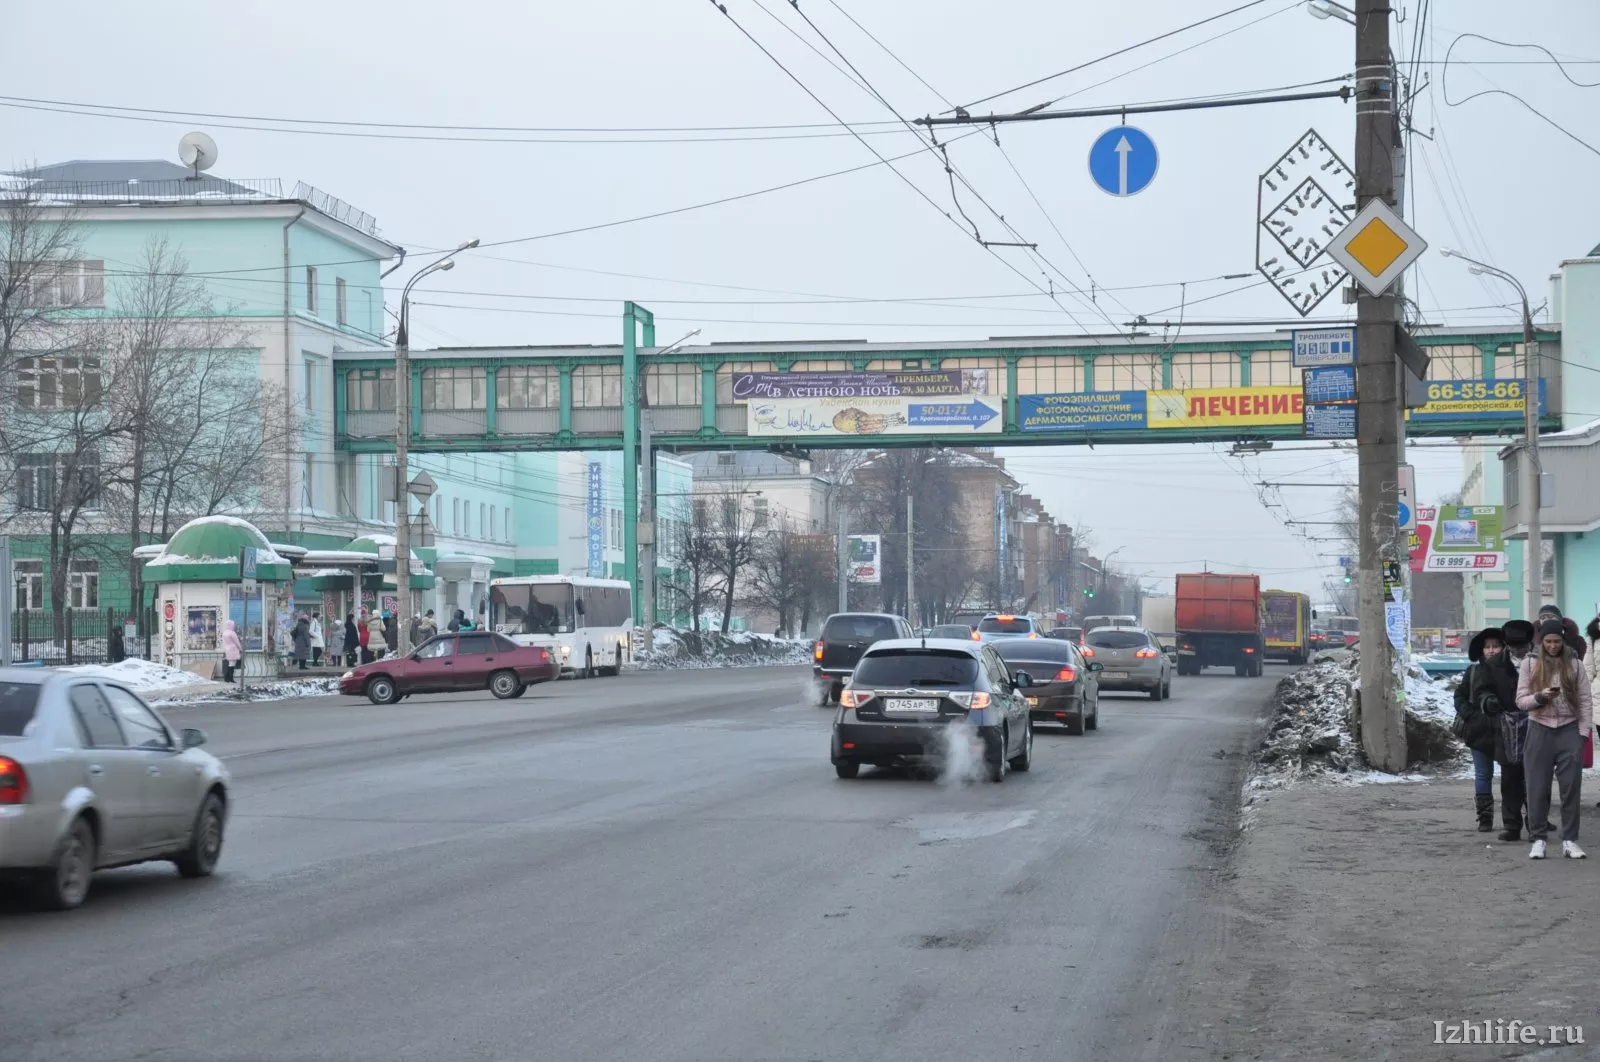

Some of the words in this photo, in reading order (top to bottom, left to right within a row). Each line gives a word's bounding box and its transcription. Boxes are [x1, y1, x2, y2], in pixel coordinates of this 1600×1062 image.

[895, 375, 950, 383] ПРЕМЬЕРА
[926, 385, 960, 393] МАРТА
[1428, 382, 1520, 399] 66-55-66
[1044, 394, 1121, 404] ФОТОЭПИЛЯЦИЯ
[1036, 404, 1132, 414] ФОТООМОЛОЖЕНИЕ
[1188, 393, 1304, 417] ЛЕЧЕНИЕ
[921, 406, 968, 416] 50-01-71
[1024, 413, 1143, 426] ДЕРМАТОКОСМЕТОЛОГИЯ
[591, 465, 600, 514] УНИВЕР
[591, 534, 600, 568] ФОТО
[1436, 558, 1444, 566] 16
[348, 591, 375, 602] РЗА
